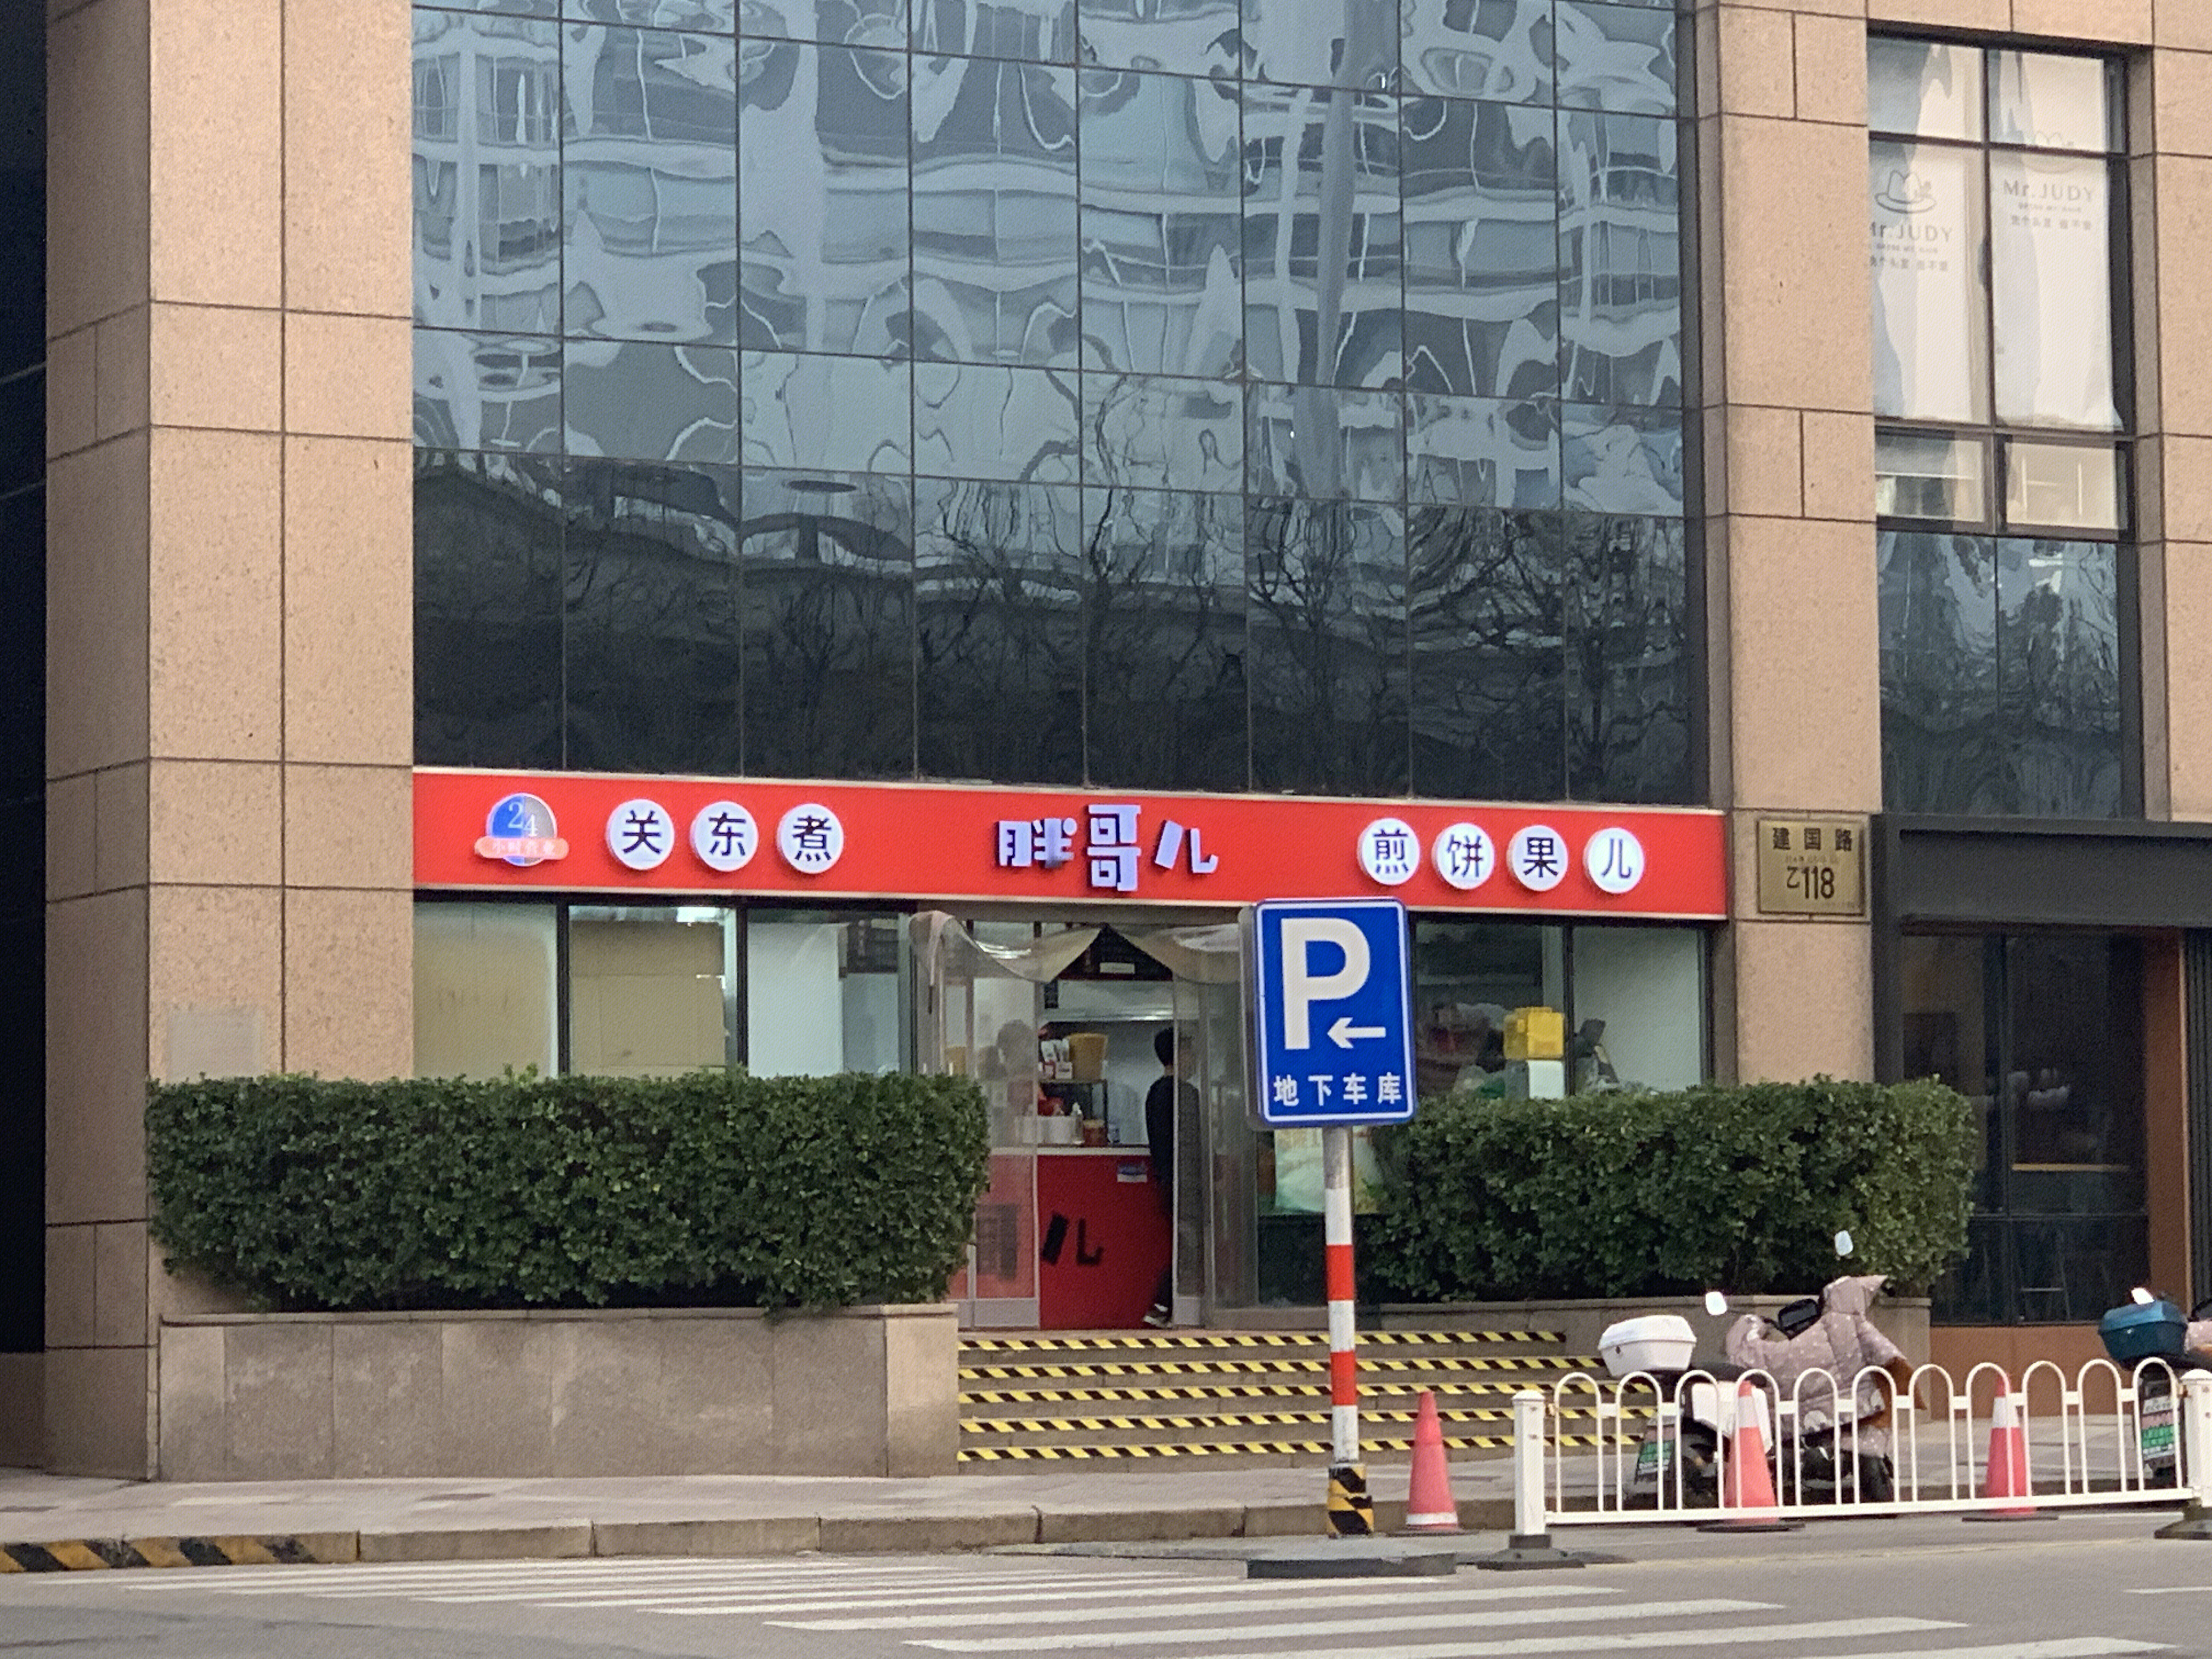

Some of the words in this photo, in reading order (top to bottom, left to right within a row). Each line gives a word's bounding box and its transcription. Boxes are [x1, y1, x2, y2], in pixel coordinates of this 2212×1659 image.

[507, 801, 539, 837] 24
[622, 810, 833, 863] 关东煮
[1772, 827, 1853, 852] 建国路
[998, 804, 1219, 891] 胖哥儿
[1373, 828, 1632, 879] 煎饼果儿
[1280, 917, 1371, 1050] P
[1273, 1071, 1402, 1107] 地下车库
